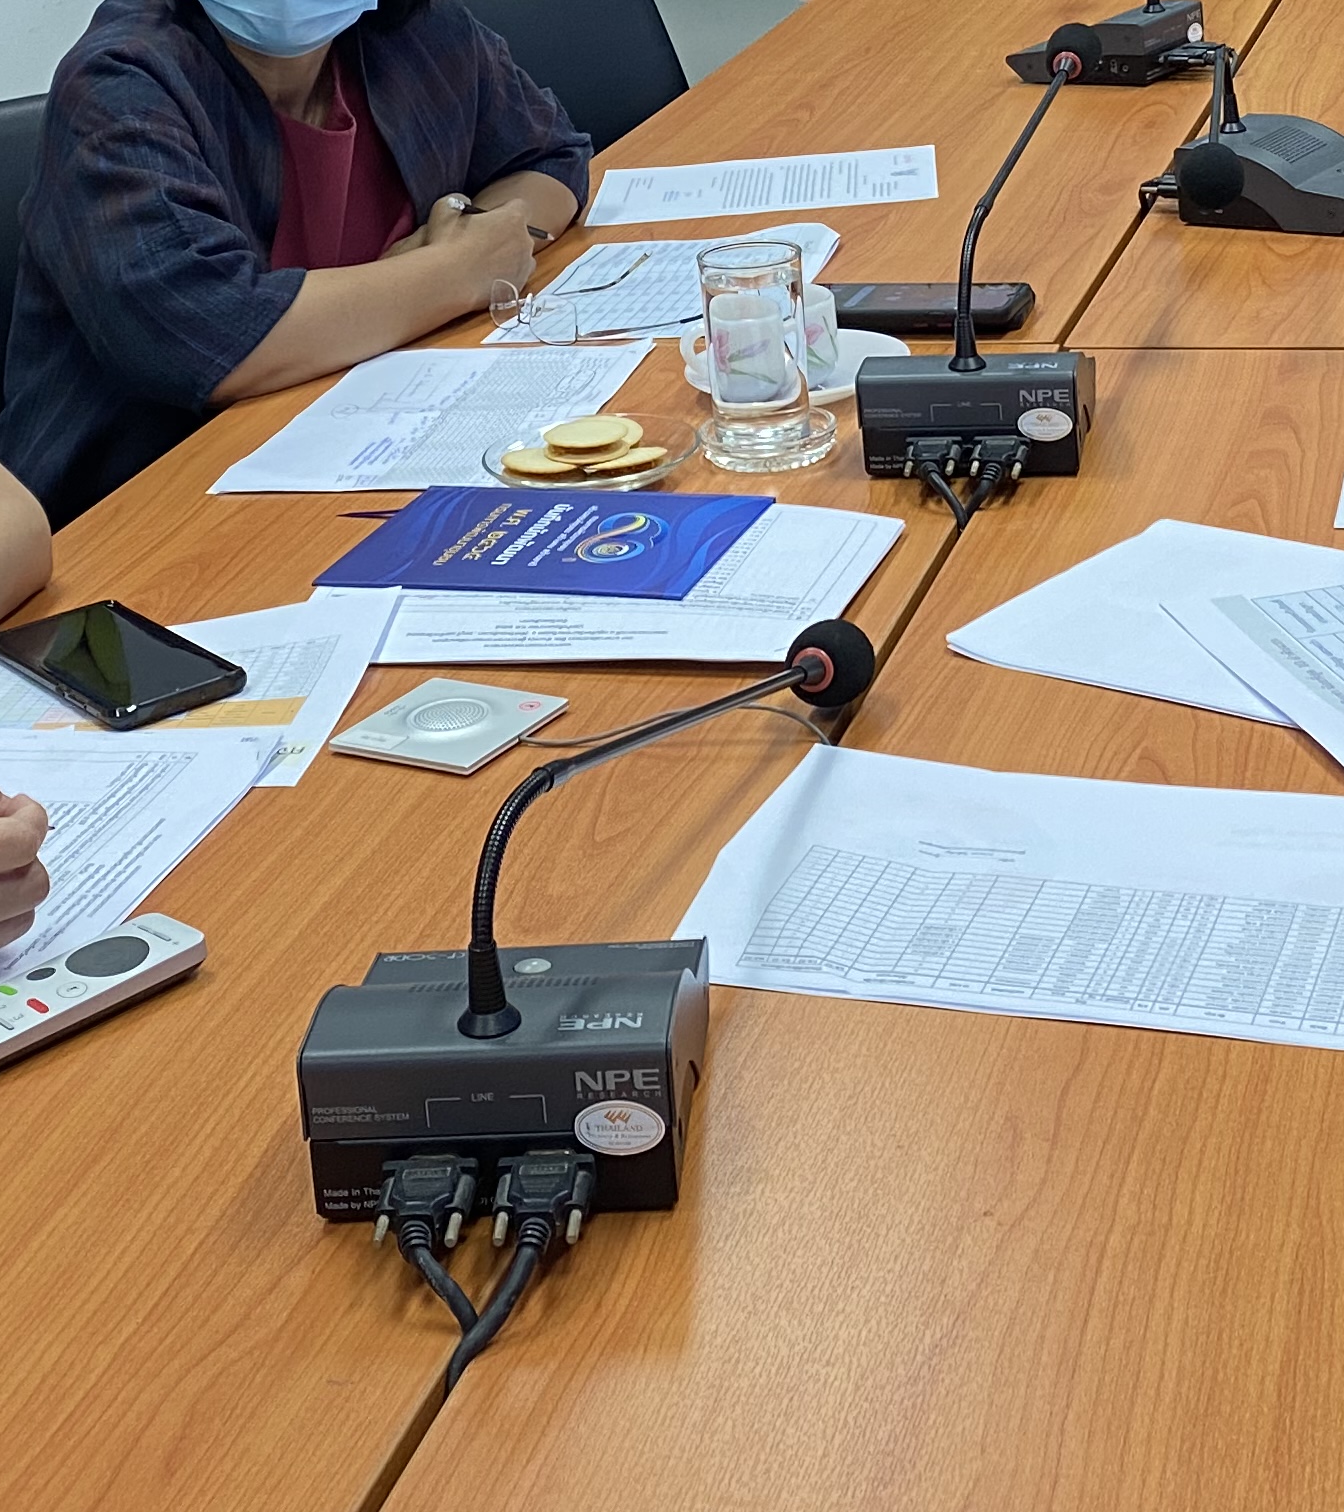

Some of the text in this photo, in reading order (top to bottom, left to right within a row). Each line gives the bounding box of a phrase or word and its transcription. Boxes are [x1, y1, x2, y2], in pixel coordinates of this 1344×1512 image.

[1019, 389, 1069, 403] NPE
[491, 503, 574, 566] บันทึกนักพัฒนา
[557, 1017, 643, 1031] NPE
[574, 1068, 661, 1091] NPE
[471, 1093, 495, 1102] LINE
[576, 1091, 662, 1099] RESEARCH
[312, 1106, 377, 1115] PROFESSIONAL
[312, 1112, 410, 1124] CONFERENCE SYSTEM
[594, 1124, 643, 1132] THAILAND
[323, 1188, 349, 1197] Made
[324, 1201, 349, 1210] Made
[350, 1201, 362, 1211] by
